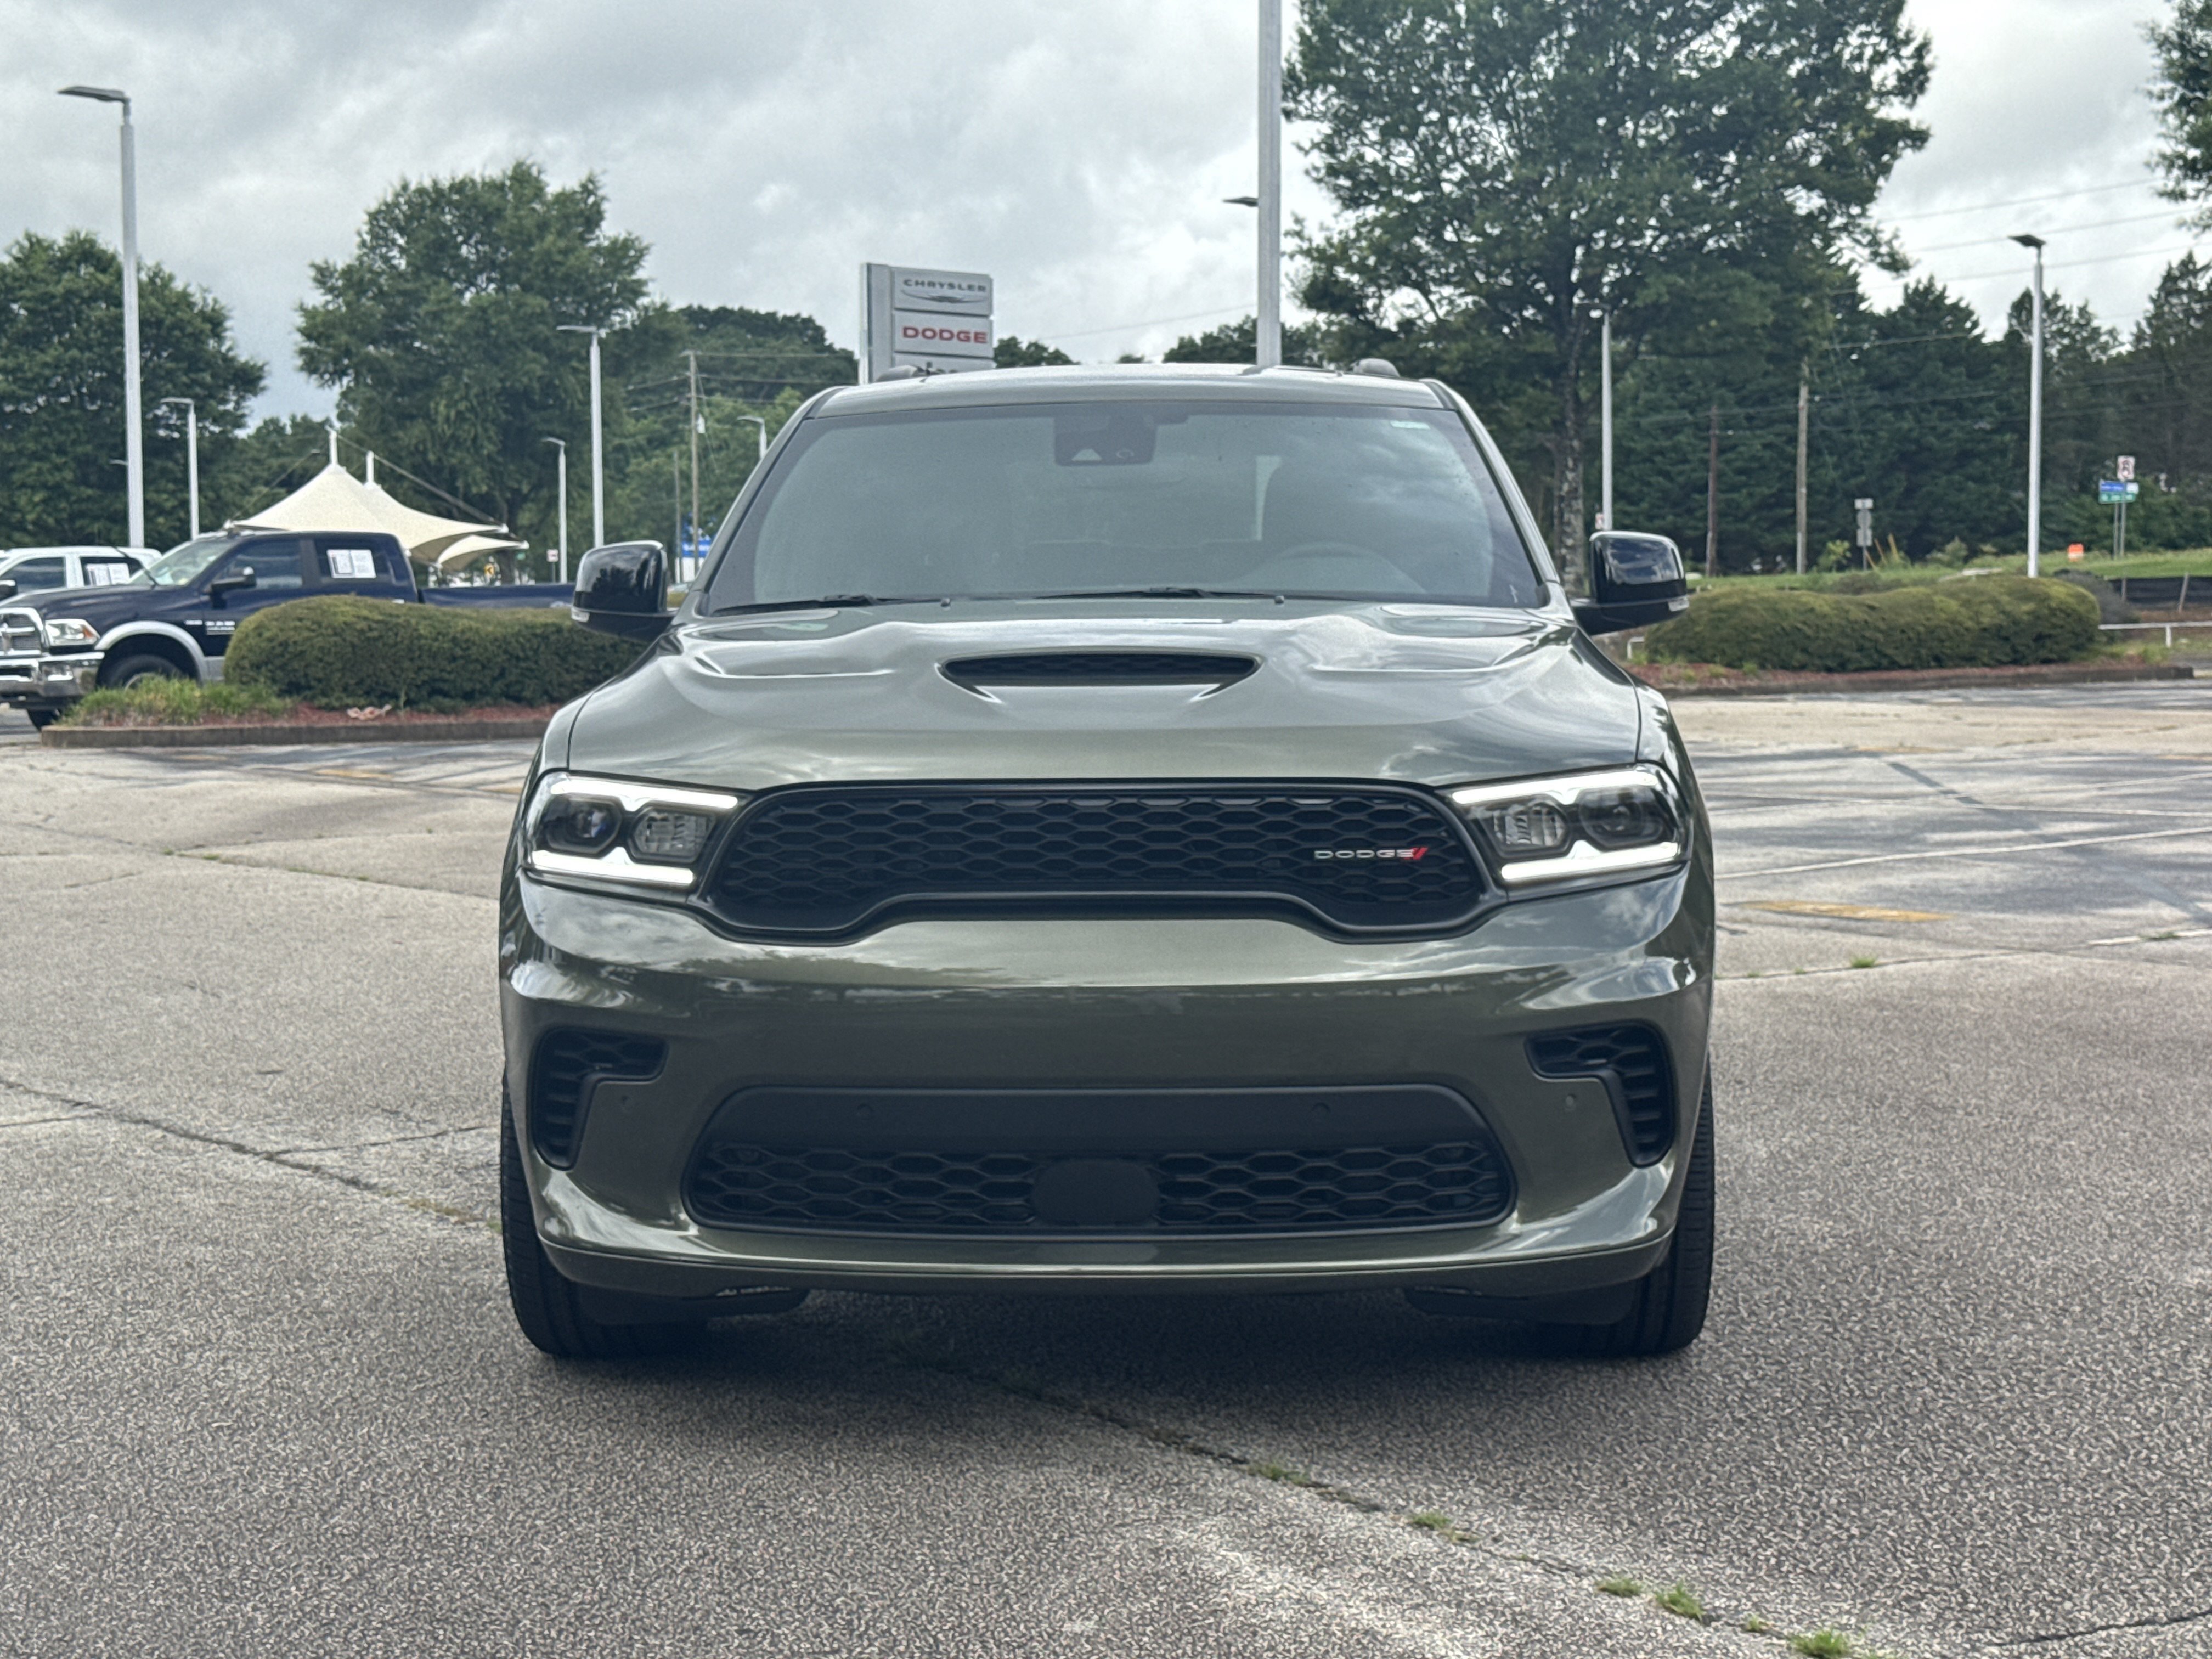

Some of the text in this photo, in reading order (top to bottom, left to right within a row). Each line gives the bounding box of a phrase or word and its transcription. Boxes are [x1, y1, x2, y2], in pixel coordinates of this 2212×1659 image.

[902, 279, 987, 292] CHRYSLER
[902, 326, 988, 343] DODGE
[1314, 849, 1414, 859] DODGE
